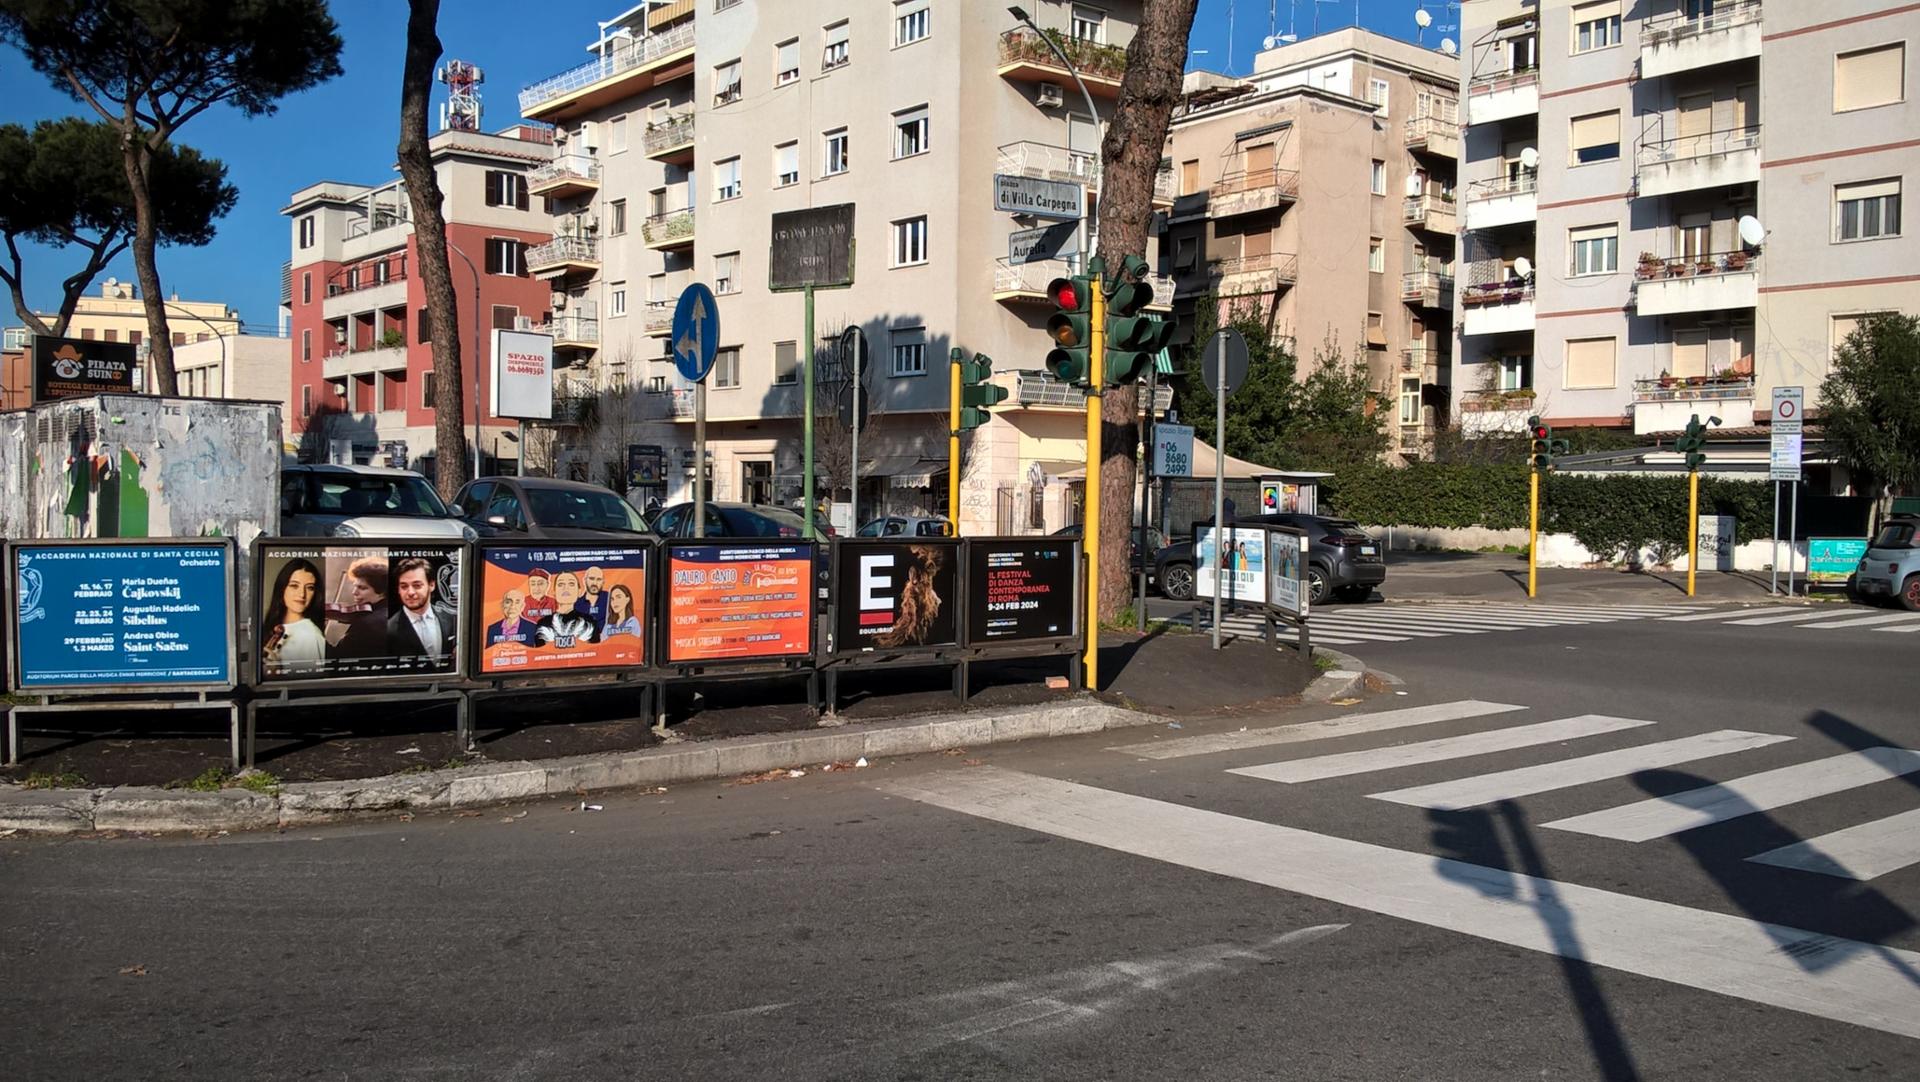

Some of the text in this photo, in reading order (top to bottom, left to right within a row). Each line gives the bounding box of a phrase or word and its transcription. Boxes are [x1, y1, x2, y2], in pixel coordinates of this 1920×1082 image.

[1001, 191, 1076, 212] di Villa Carpegna
[1013, 243, 1046, 258] Aurelia
[508, 353, 544, 361] SPAZIO
[87, 360, 126, 370] PIRATA
[48, 382, 81, 390] BOTTEGA
[1166, 442, 1177, 452] 06
[1165, 453, 1187, 464] 8680
[1165, 464, 1186, 474] 2499
[534, 552, 544, 561] FEB
[708, 568, 737, 583] CANTO
[997, 570, 1031, 578] FESTIVAL
[147, 577, 178, 585] Dueñas
[860, 555, 894, 610] E
[74, 590, 113, 598] FEBBRAIO
[122, 586, 181, 600] Čajkovskij
[988, 586, 1050, 594] CONTEMPORANEA
[123, 604, 200, 614] Augustin Hadelich
[1006, 602, 1019, 610] FEB
[1020, 601, 1038, 609] 2024
[123, 615, 167, 625] Sibelius
[123, 632, 154, 640] Andrea
[859, 627, 894, 635] EQUILIBRIO
[555, 635, 576, 648] TOSCA
[124, 642, 189, 652] Saint-Saëns
